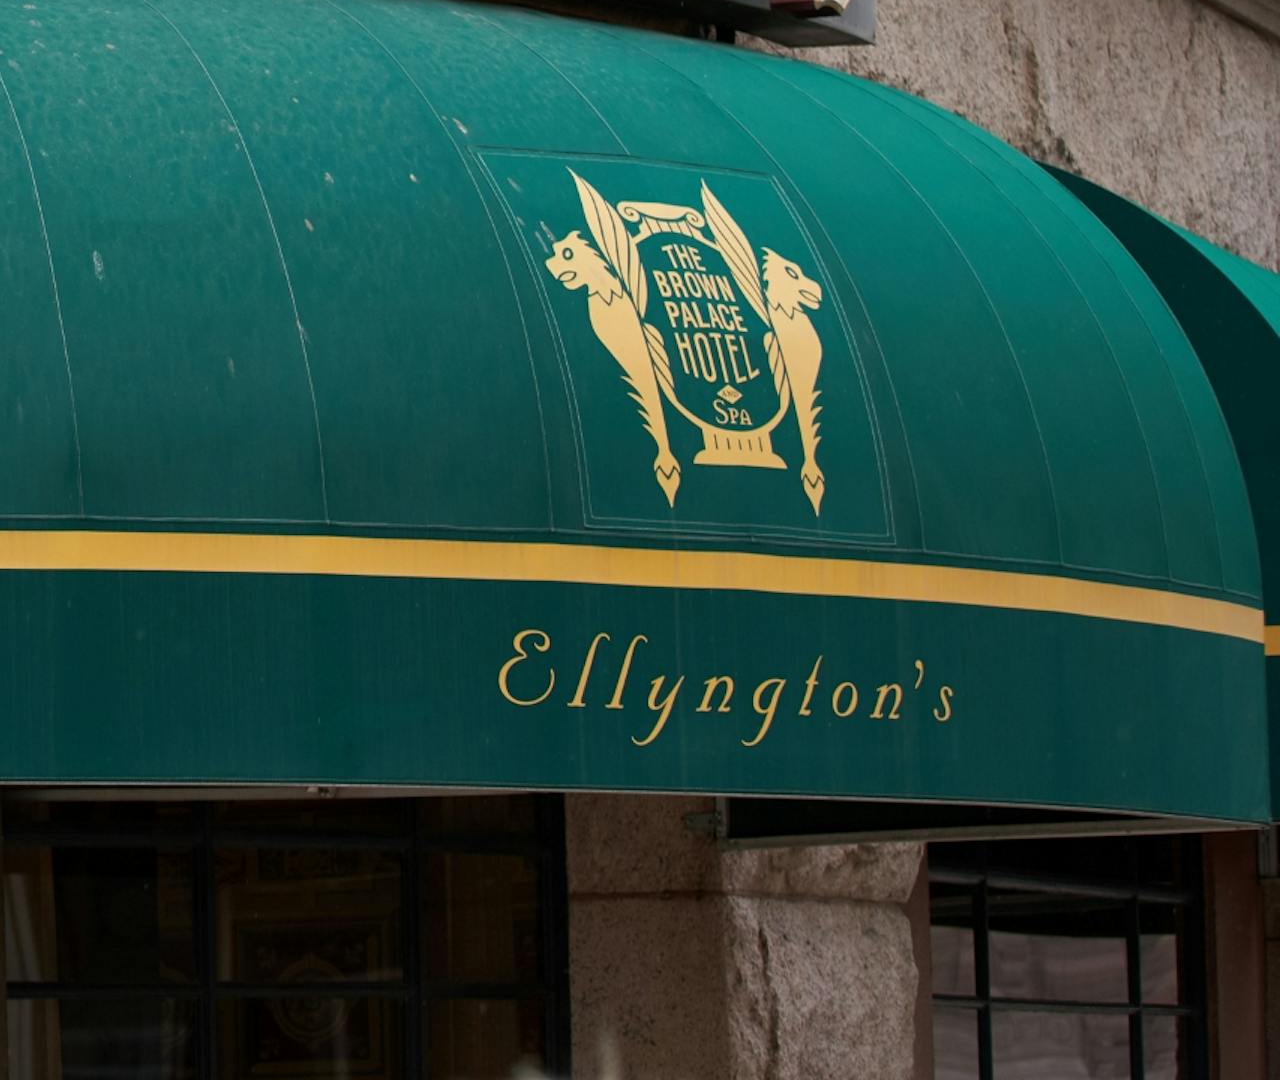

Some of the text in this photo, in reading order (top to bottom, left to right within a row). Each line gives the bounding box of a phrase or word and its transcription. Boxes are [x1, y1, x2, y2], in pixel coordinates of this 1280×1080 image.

[661, 243, 706, 271] THE
[652, 270, 736, 302] BROWN
[664, 301, 748, 332] PALACE
[674, 332, 760, 383] HOTEL
[498, 629, 954, 747] Ellyngton's
